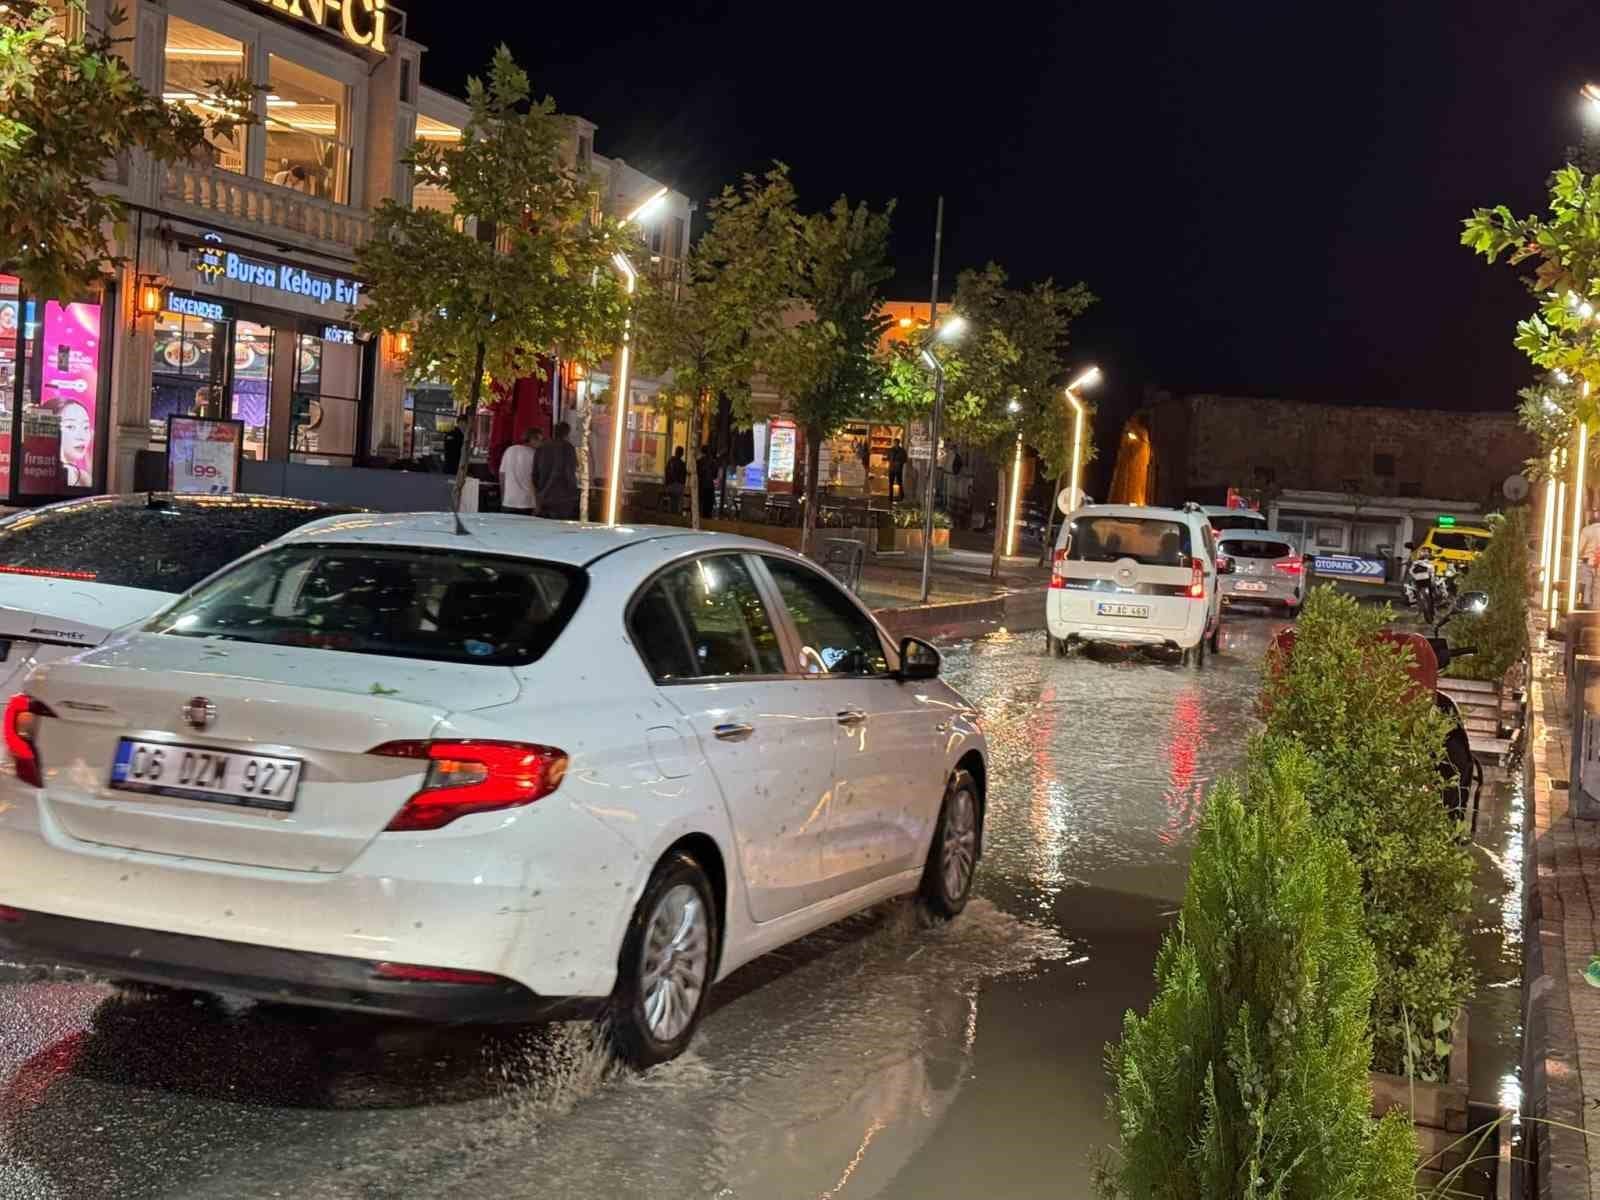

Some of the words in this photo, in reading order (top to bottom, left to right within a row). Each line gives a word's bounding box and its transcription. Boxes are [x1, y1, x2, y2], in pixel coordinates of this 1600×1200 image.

[226, 252, 276, 288] Bursa
[280, 265, 331, 304] Kebap
[335, 278, 359, 305] Evi
[168, 292, 223, 319] İSKENDER
[1315, 559, 1354, 570] OTOPARK
[131, 747, 164, 780] 06
[243, 760, 297, 797] 927
